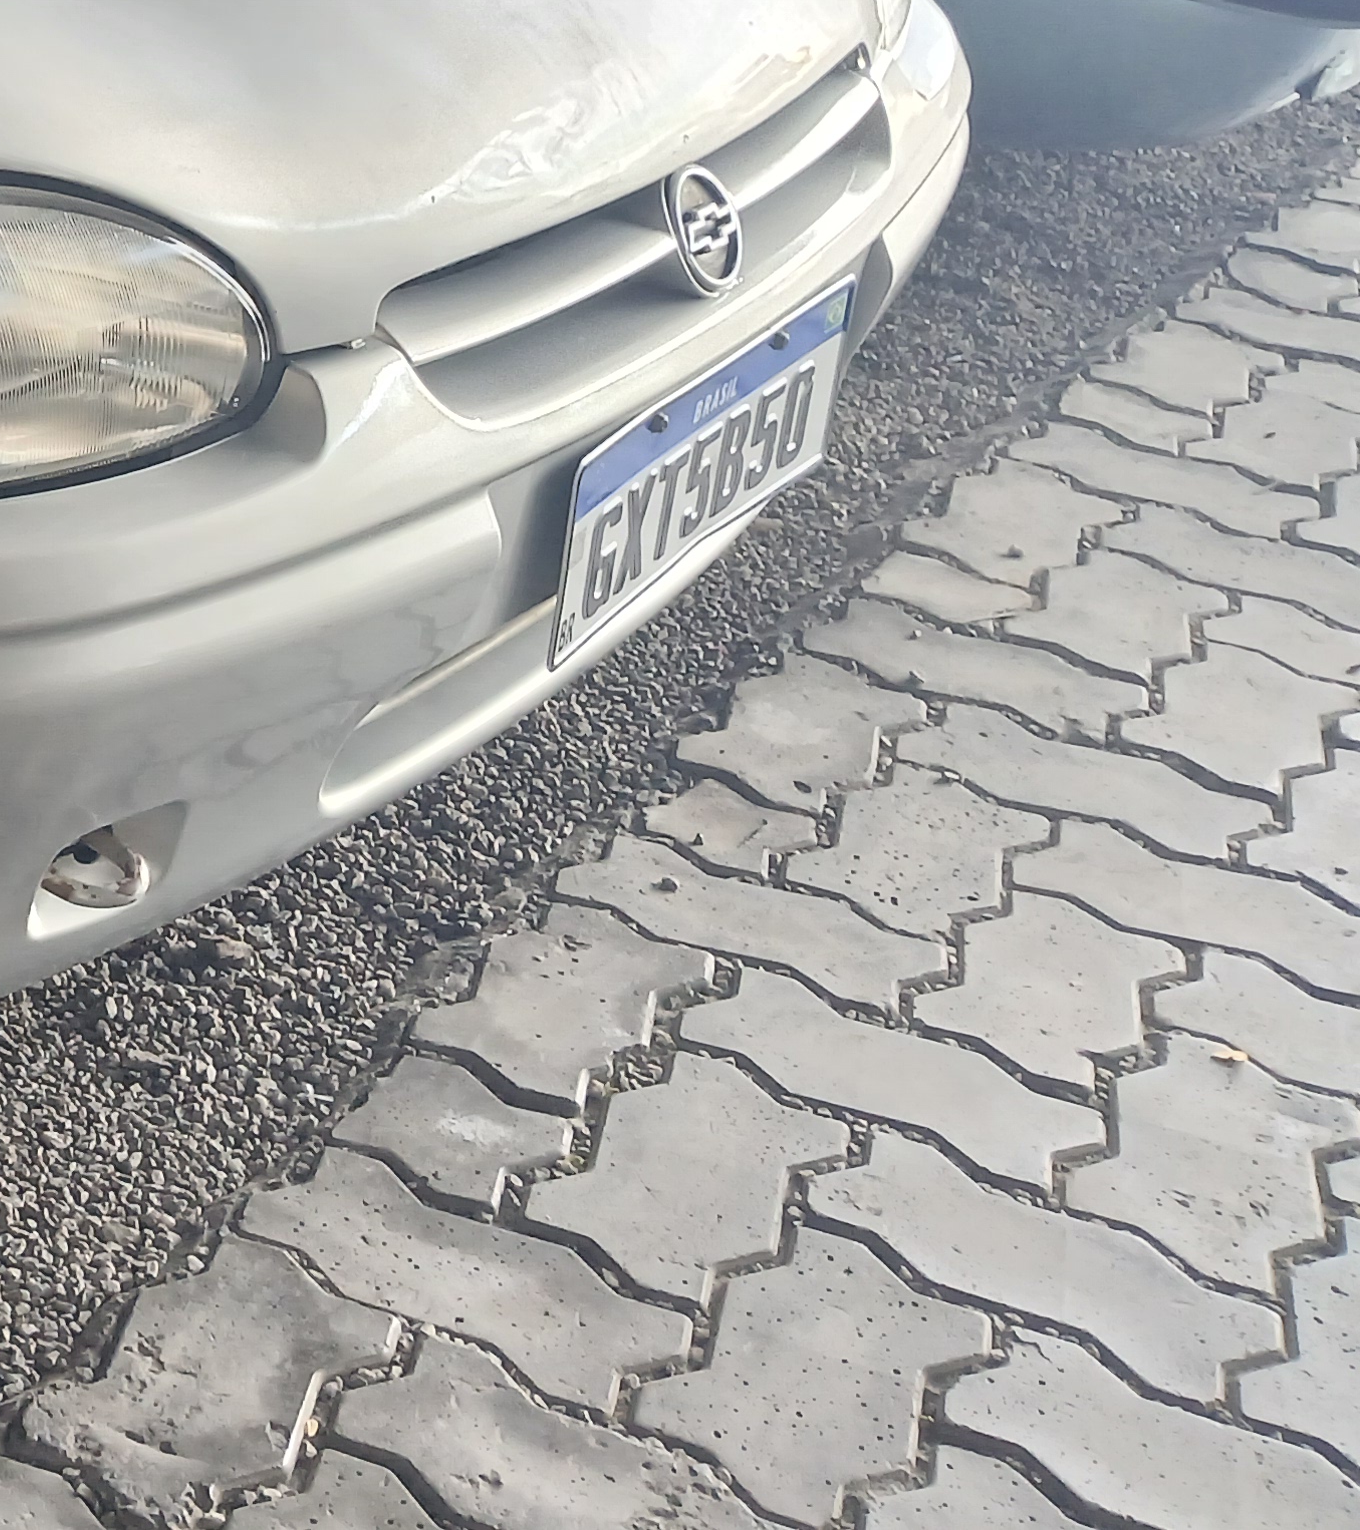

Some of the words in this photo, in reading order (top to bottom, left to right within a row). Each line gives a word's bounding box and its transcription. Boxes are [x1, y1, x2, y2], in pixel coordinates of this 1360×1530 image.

[692, 376, 740, 424] BRASIL
[582, 360, 816, 619] GXT5B50
[557, 612, 576, 653] BR
